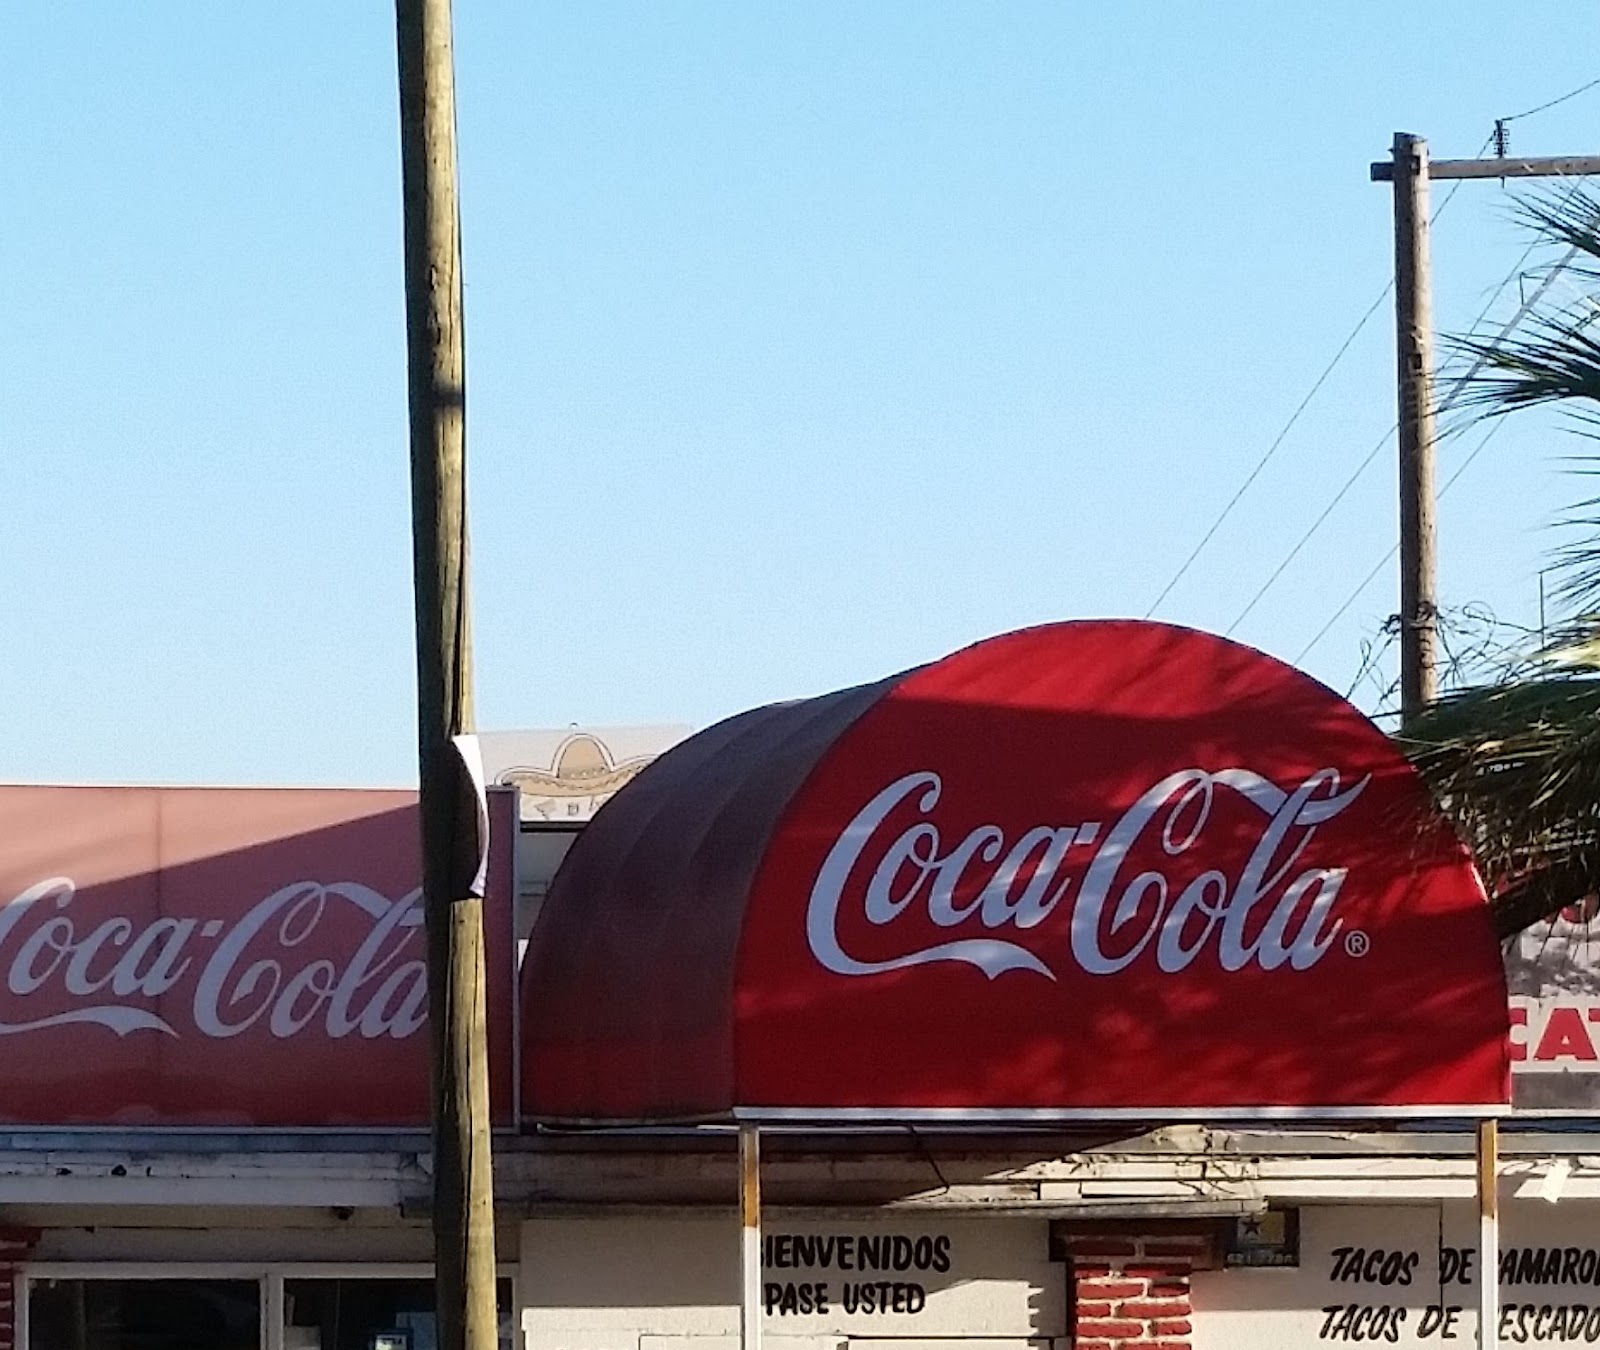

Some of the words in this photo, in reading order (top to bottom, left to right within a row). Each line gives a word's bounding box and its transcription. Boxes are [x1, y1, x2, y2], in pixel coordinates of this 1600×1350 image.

[807, 767, 1371, 981] Coca-Cola
[761, 1235, 950, 1273] IENVENIDOS
[1330, 1247, 1419, 1286] TACOS
[1439, 1248, 1476, 1285] DE
[764, 1282, 829, 1316] PASE
[843, 1281, 926, 1315] USTED
[1319, 1304, 1407, 1343] TACOS
[1417, 1306, 1463, 1339] DE
